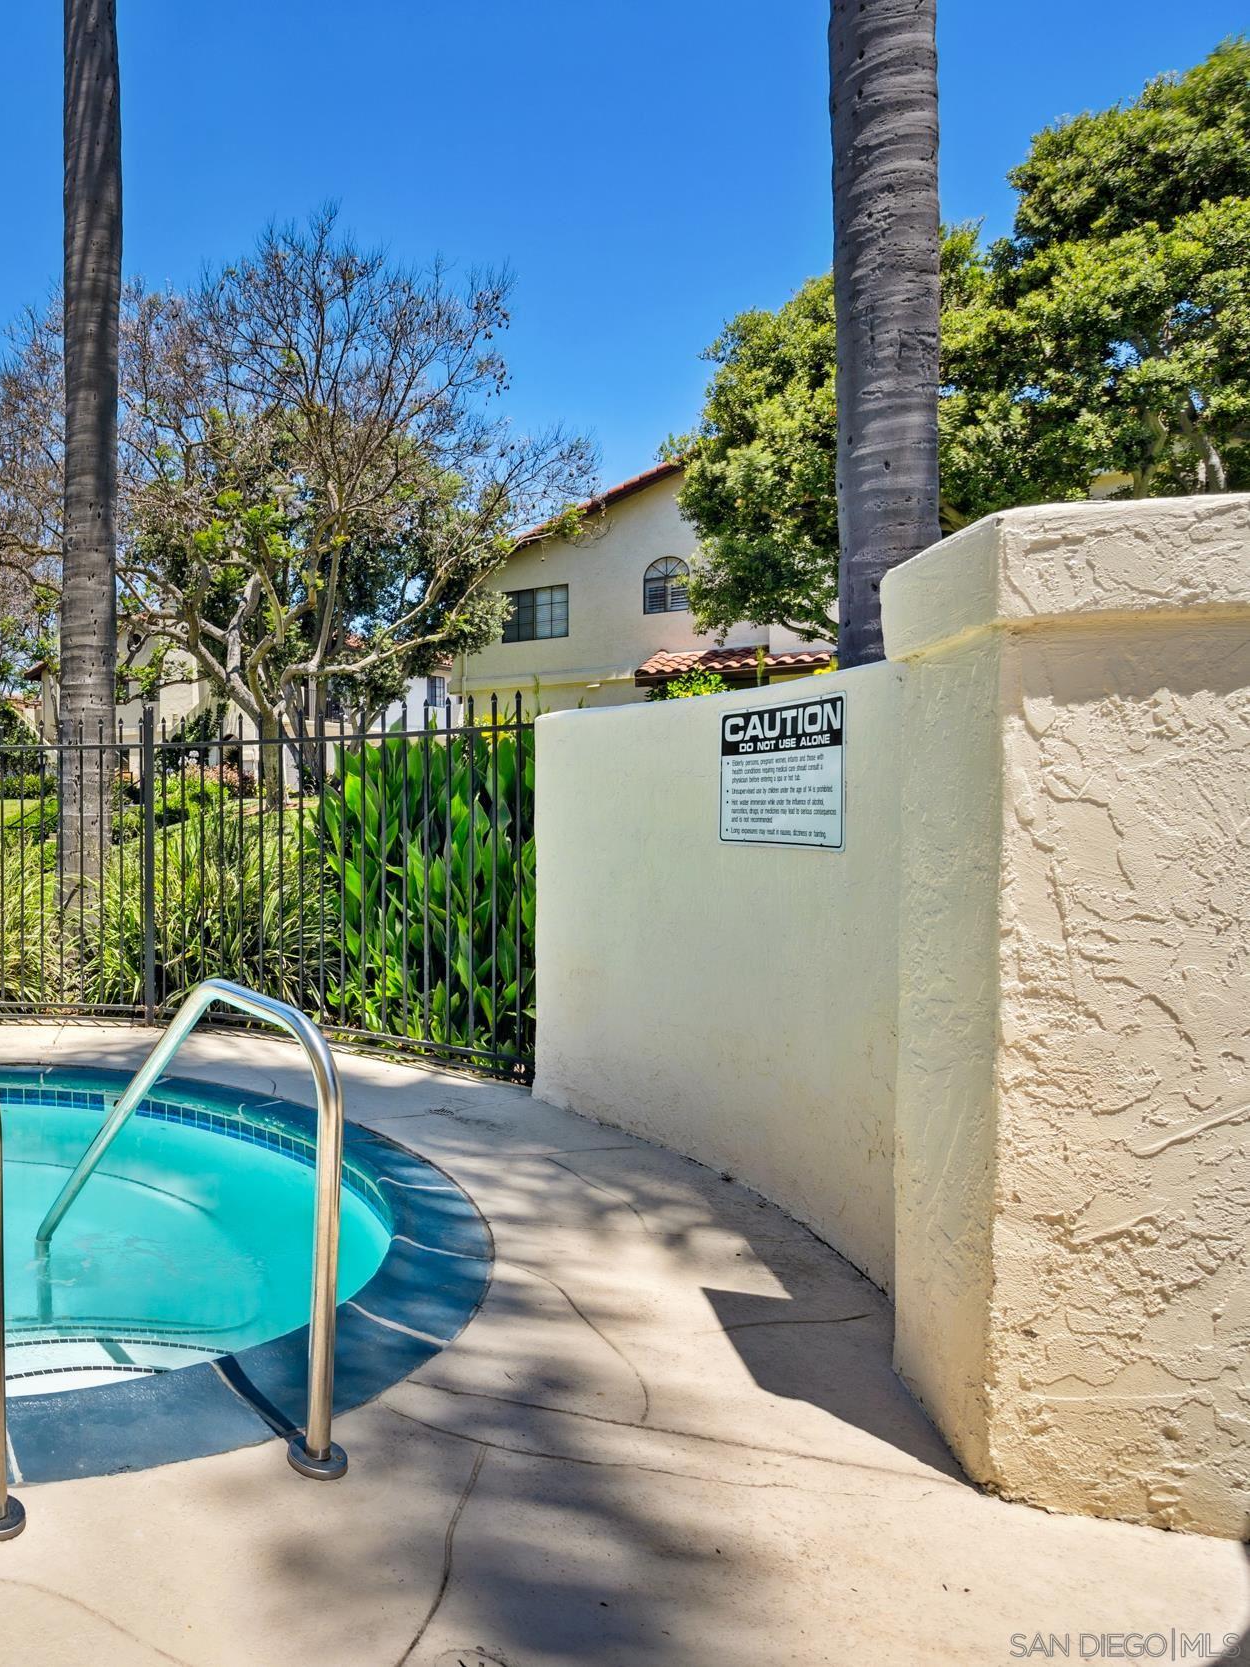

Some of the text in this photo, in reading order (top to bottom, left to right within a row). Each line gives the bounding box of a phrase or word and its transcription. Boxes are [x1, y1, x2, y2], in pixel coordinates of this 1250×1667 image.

[725, 701, 841, 742] CAUTION
[739, 734, 830, 752] DO NOT USE ALONE
